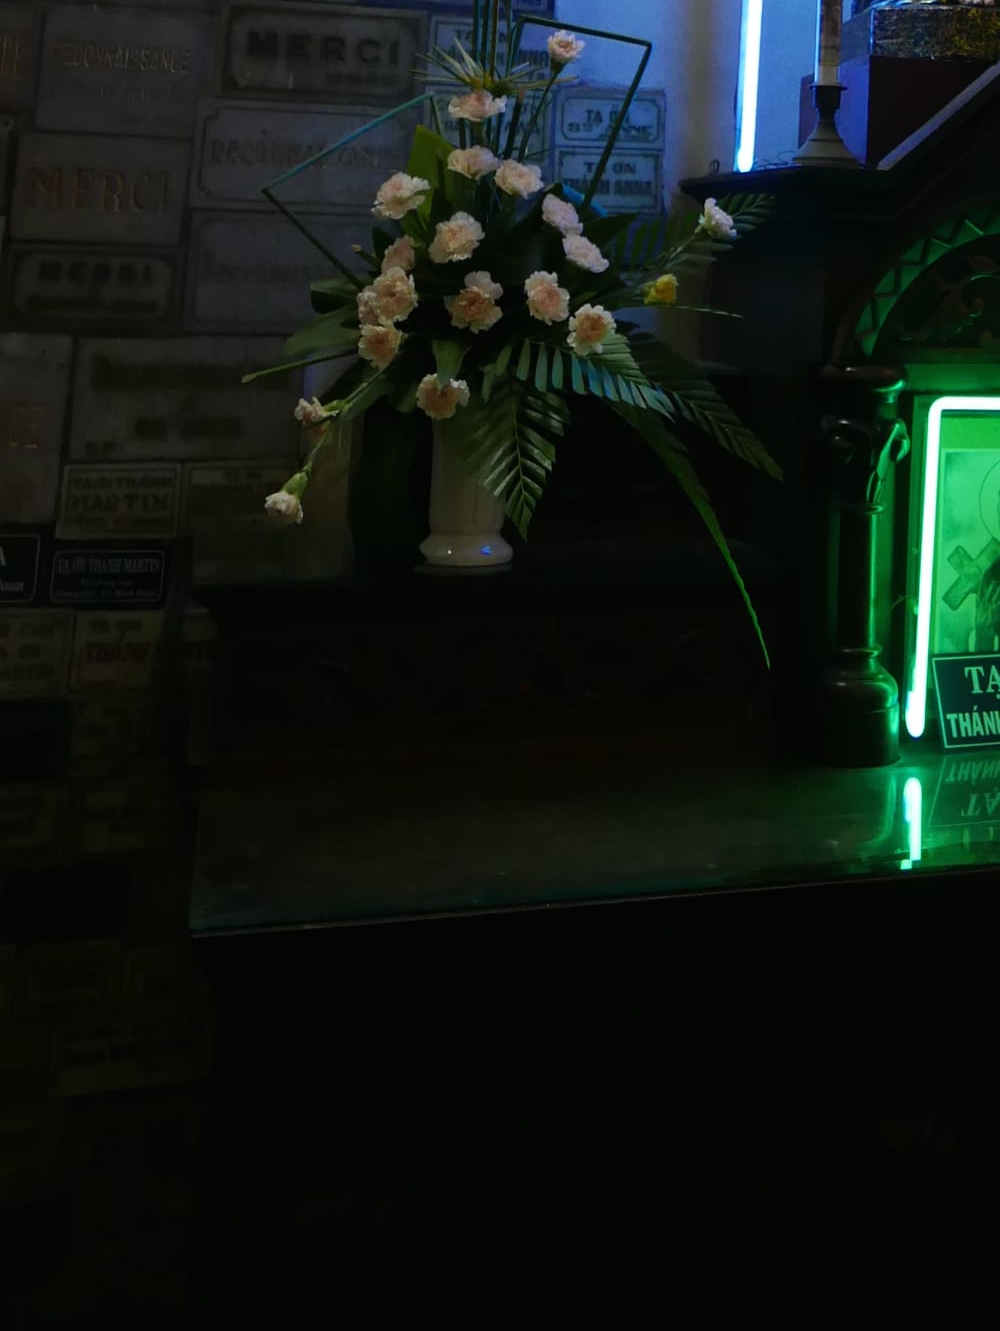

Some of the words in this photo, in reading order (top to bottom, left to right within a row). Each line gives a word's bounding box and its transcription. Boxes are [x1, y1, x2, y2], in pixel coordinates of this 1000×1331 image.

[246, 30, 399, 66] MERCI
[30, 166, 170, 214] MERCI
[71, 494, 170, 512] MARTIN
